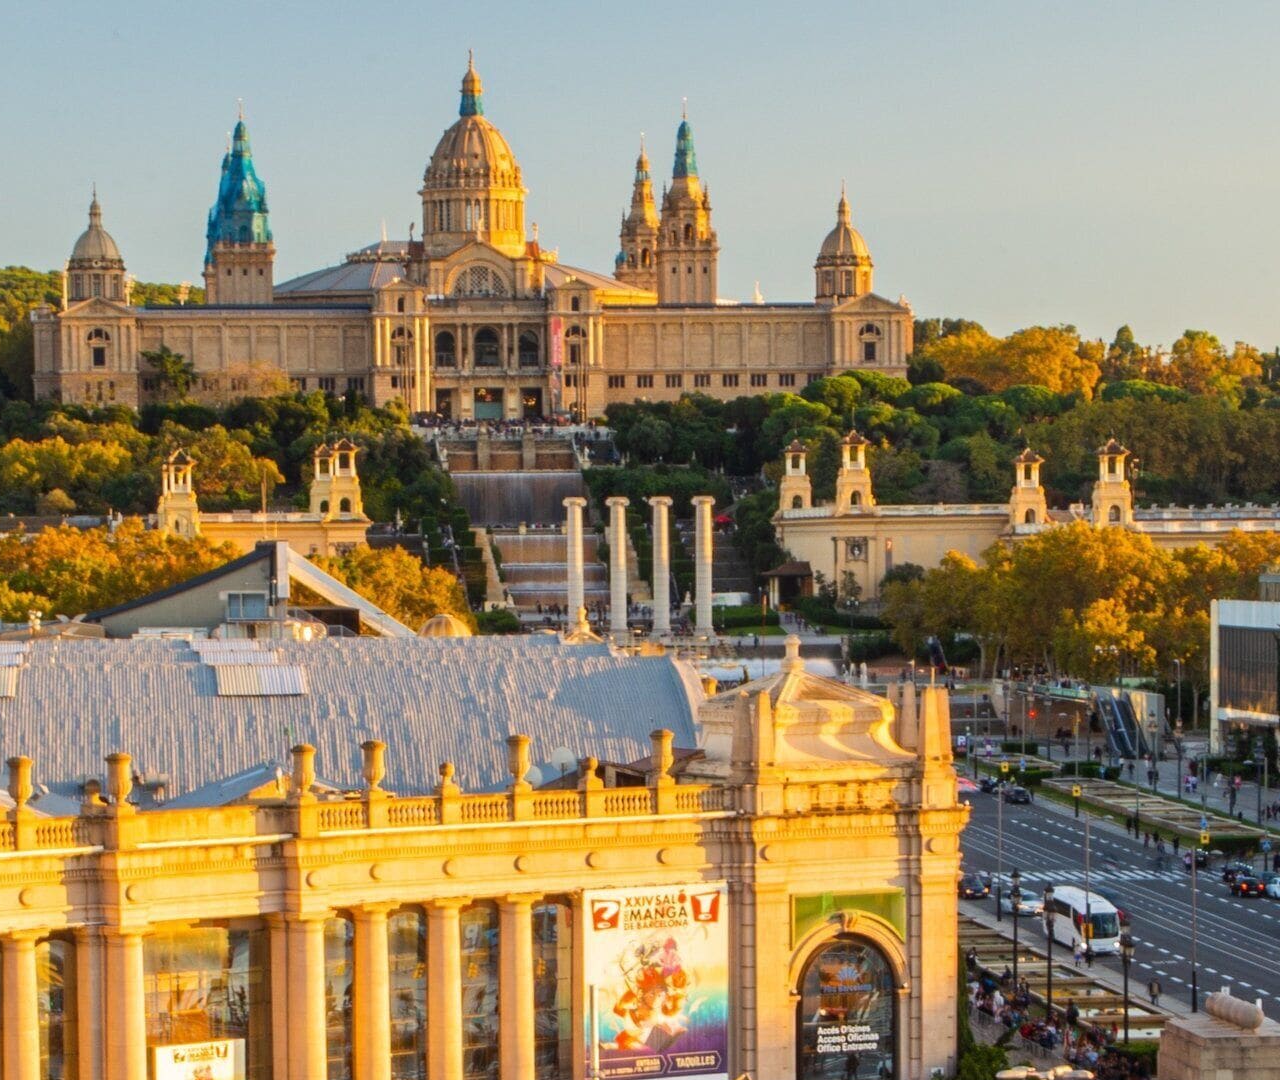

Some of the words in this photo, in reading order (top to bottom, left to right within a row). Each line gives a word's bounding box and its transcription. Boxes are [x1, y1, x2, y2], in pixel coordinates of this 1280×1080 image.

[625, 896, 654, 907] XXIV
[655, 889, 687, 905] SALÓ
[630, 906, 688, 921] MANGA
[624, 922, 635, 931] DE
[637, 919, 688, 930] BARCELONA
[817, 1035, 846, 1044] Acceso
[847, 1033, 880, 1042] Oficinas
[817, 1044, 841, 1053] Office
[842, 1042, 878, 1051] Entrance
[676, 1055, 715, 1069] TAQUILLES
